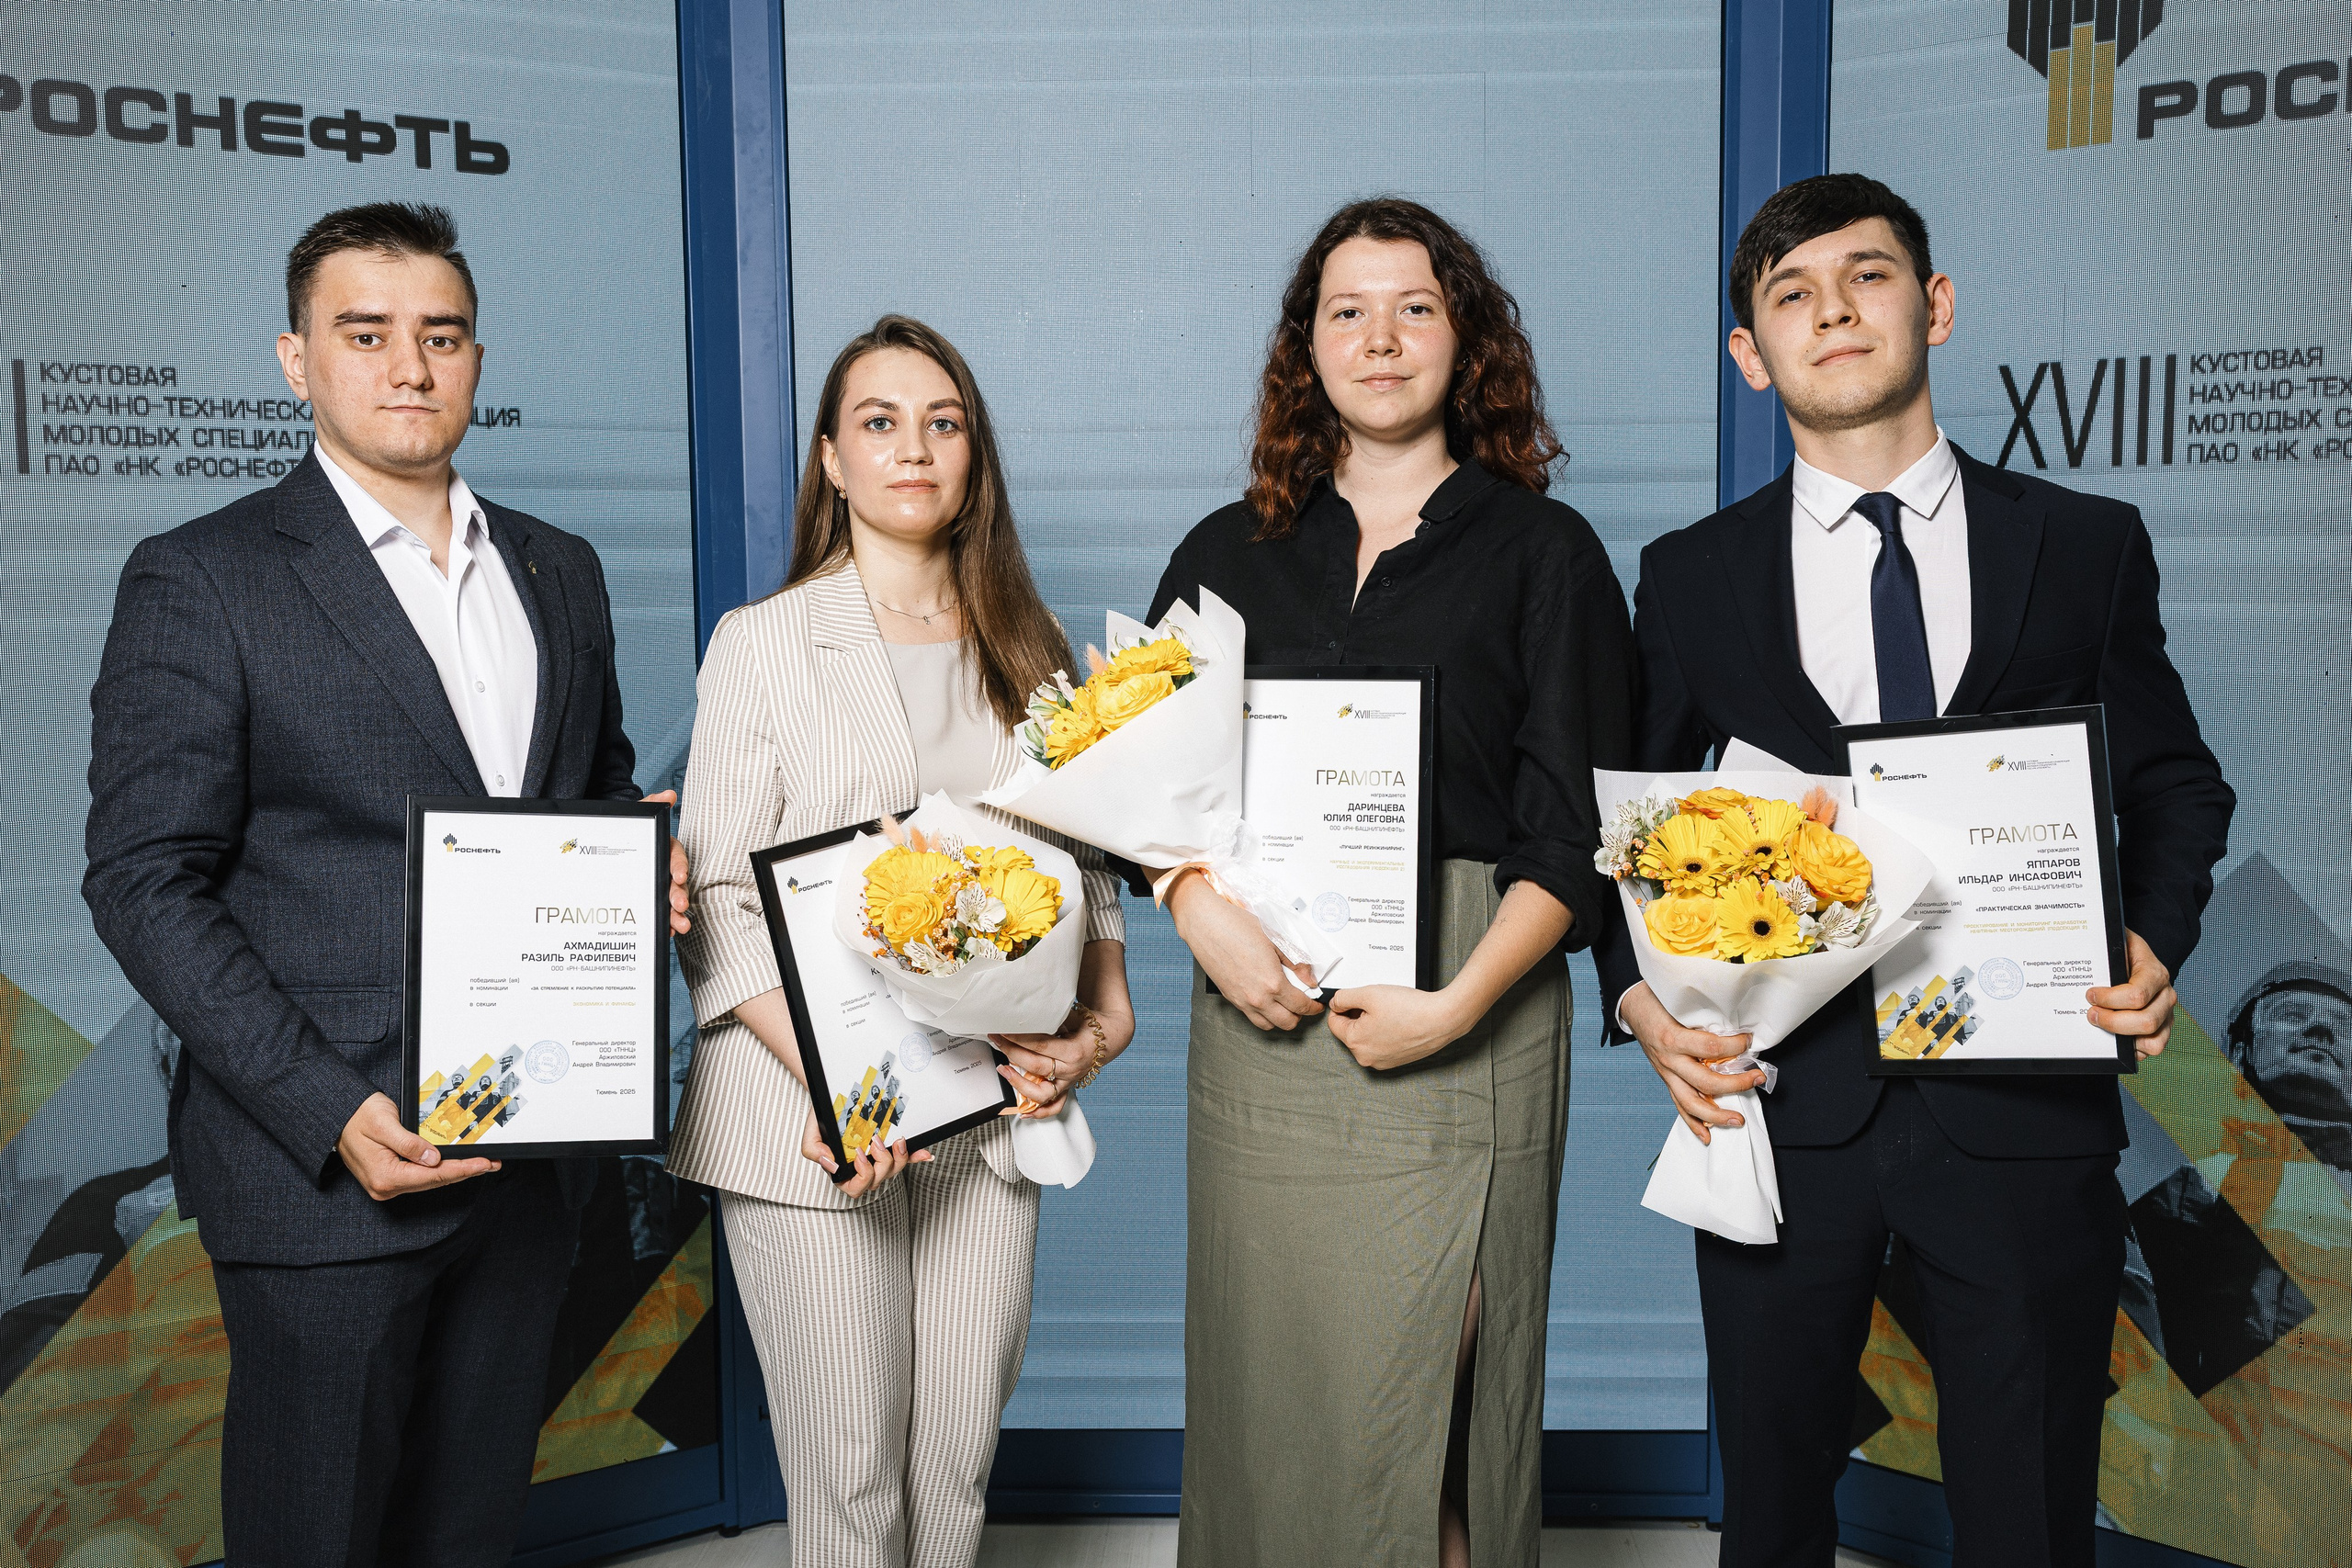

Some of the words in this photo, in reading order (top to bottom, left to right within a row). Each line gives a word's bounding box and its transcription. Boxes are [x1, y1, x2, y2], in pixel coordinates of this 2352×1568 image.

[2137, 58, 2352, 141] РОС
[2189, 345, 2323, 374] КУСТОВАЯ
[40, 362, 176, 388] КУСТОВАЯ
[41, 392, 314, 422] НАУЧНО-ТЕХНИЧЕСК
[1997, 354, 2177, 470] XVIII
[2188, 409, 2322, 436] МОЛОДЫХ
[42, 423, 179, 448] МОЛОДЫХ
[193, 427, 315, 452] СПЕЦИАЛ
[2187, 442, 2238, 465] ПАО
[2252, 439, 2299, 462] «НК
[45, 454, 99, 476] ПАО
[114, 456, 162, 477] «НК
[1354, 709, 1370, 719] XVIII
[2007, 761, 2027, 772] XVIII
[1317, 770, 1406, 786] ГРАМОТА
[1882, 773, 1928, 782] РОСНЕФТЬ
[1347, 803, 1405, 812] ДАРИНЦЕВА
[1323, 814, 1351, 822] ЮЛИЯ
[1356, 814, 1405, 824] ОЛЕГОВНА
[1969, 823, 2078, 845] ГРАМОТА
[579, 845, 597, 855] XVIII
[2037, 846, 2079, 854] награждается
[2026, 858, 2080, 869] ЯППАРОВ
[1958, 874, 2003, 885] ИЛЬДАР
[2009, 870, 2082, 882] ИНСАФОВИЧ
[797, 879, 832, 893] РОСНЕФТЬ
[2007, 883, 2083, 892] «РН-БАШНИПИНЕФТЬ»
[1975, 904, 2031, 912] «ПРАКТИЧЕСКАЯ
[2035, 902, 2086, 910] ЗНАЧИМОСТЬ»
[536, 907, 636, 924] ГРАМОТА
[563, 942, 636, 952] АХМАДИШИН
[521, 953, 564, 962] РАЗИЛЬ
[570, 953, 636, 962] РАФИЛЕВИЧ
[840, 995, 867, 1007] победивший
[850, 1019, 865, 1027] секции
